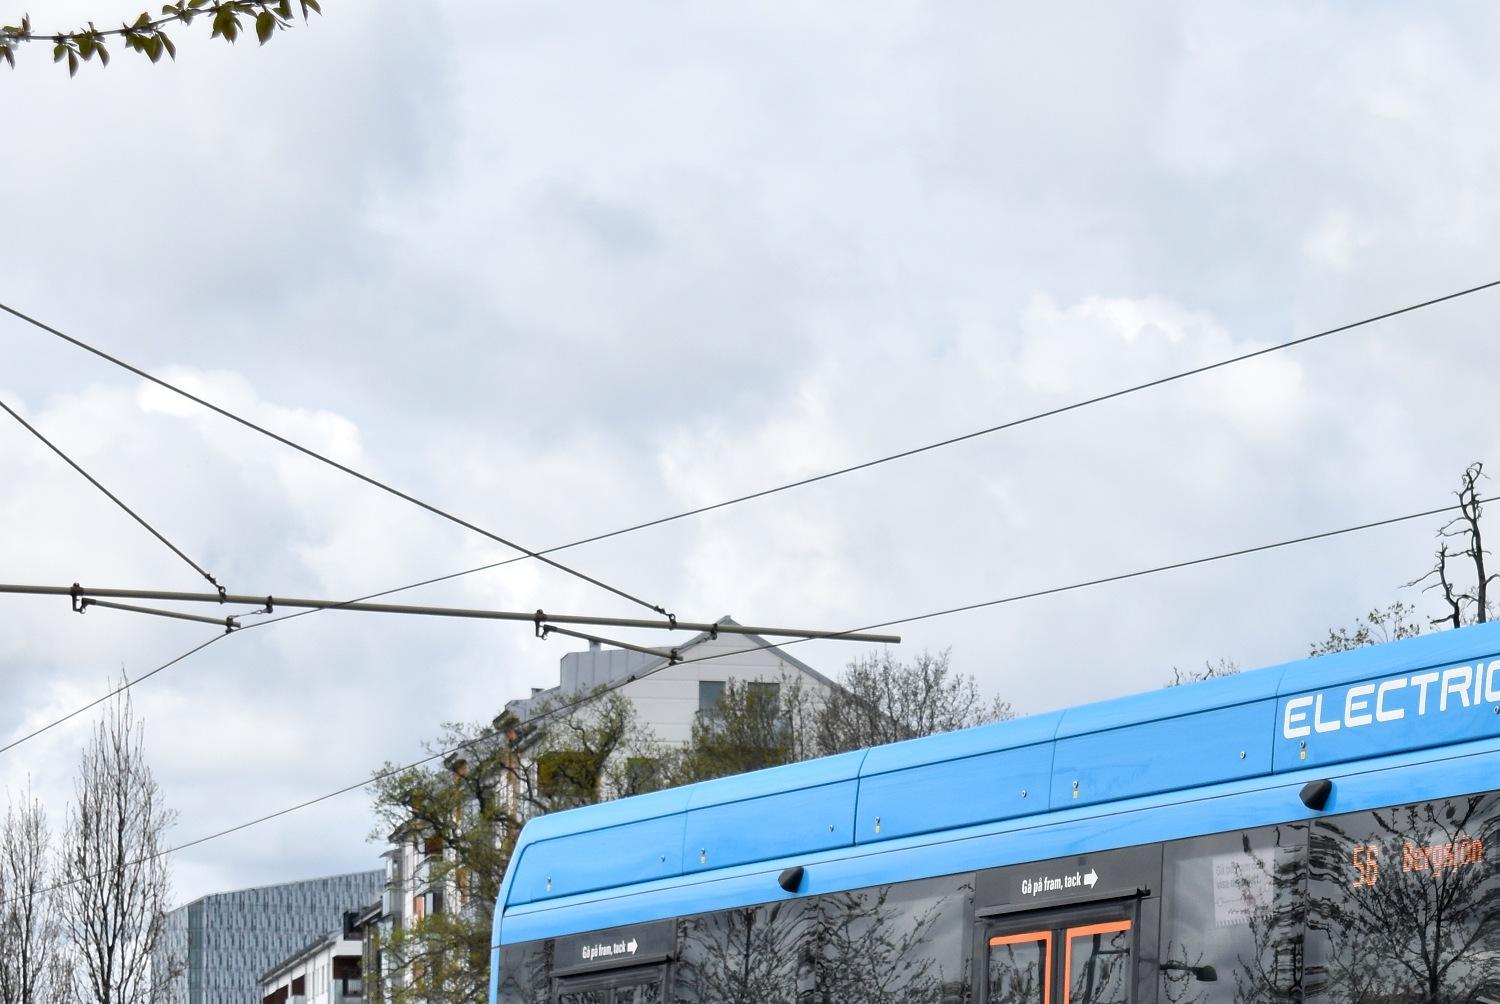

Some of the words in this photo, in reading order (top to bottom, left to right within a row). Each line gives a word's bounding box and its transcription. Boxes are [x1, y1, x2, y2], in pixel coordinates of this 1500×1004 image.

[1352, 844, 1379, 888] 56
[1021, 878, 1032, 895] Gå
[1033, 876, 1043, 897] på
[1044, 876, 1063, 891] fram,
[1064, 871, 1081, 888] tack
